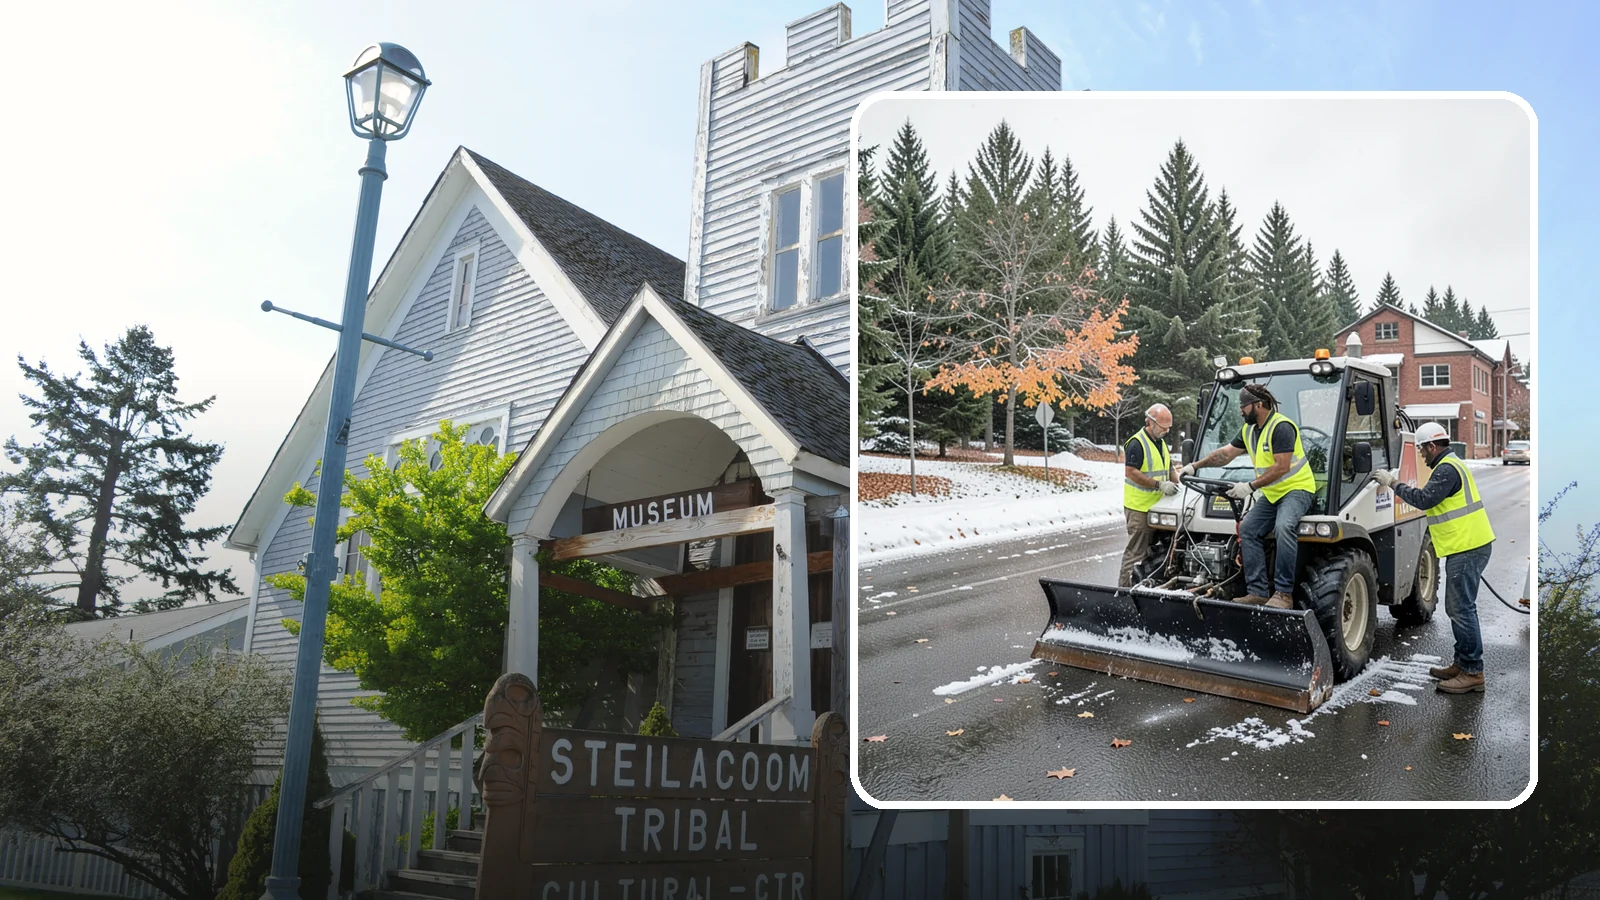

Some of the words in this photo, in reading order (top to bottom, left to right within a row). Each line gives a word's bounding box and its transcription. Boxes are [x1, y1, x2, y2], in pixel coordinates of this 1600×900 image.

[613, 492, 713, 531] MUSEUM
[551, 738, 809, 792] STEILACOOM
[614, 807, 758, 852] TRIBAL
